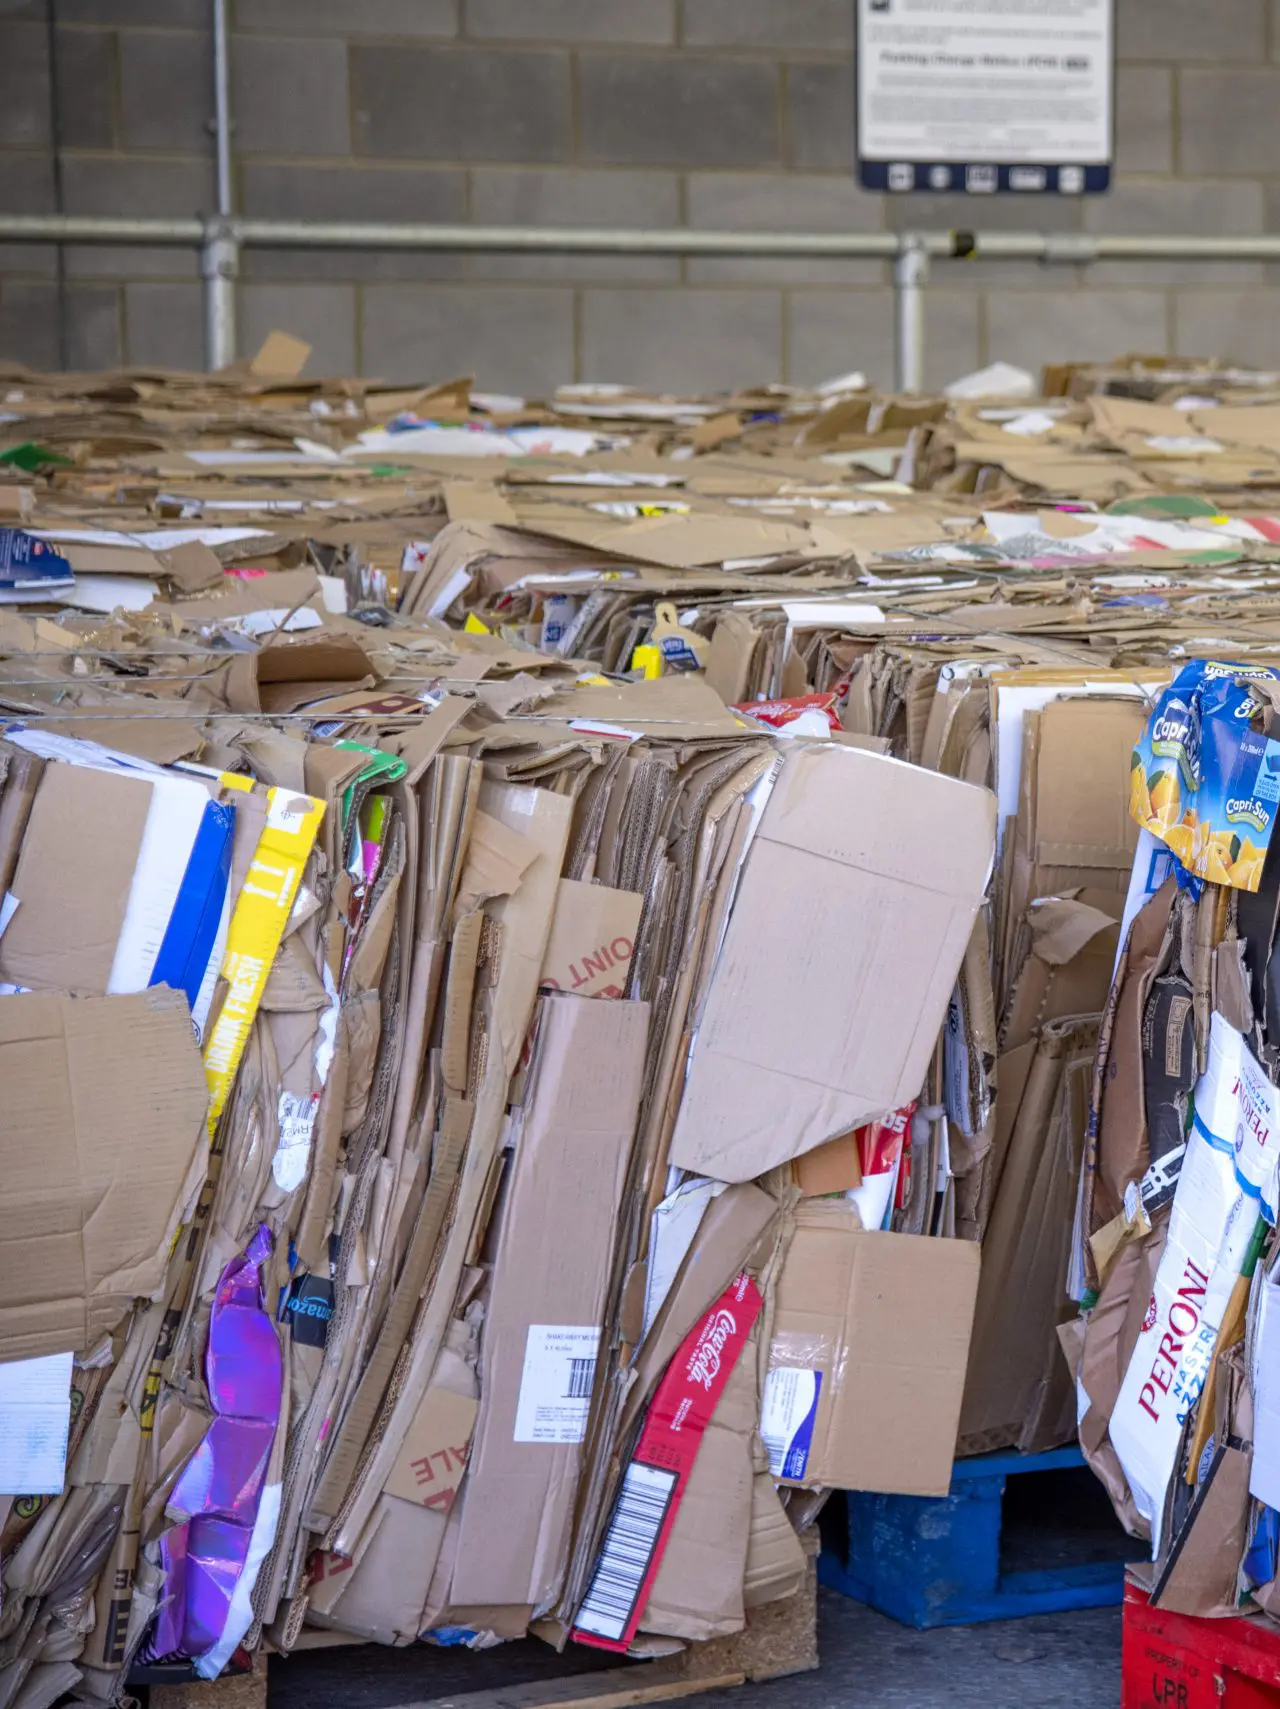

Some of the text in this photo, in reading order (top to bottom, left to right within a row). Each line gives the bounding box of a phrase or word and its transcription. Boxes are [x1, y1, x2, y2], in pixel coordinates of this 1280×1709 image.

[1226, 797, 1270, 825] Capri-Sun
[204, 954, 264, 1073] DRINK FRESH
[1232, 1077, 1270, 1147] PERONI
[1137, 1257, 1209, 1423] PERONI
[1153, 1672, 1189, 1709] LPR
